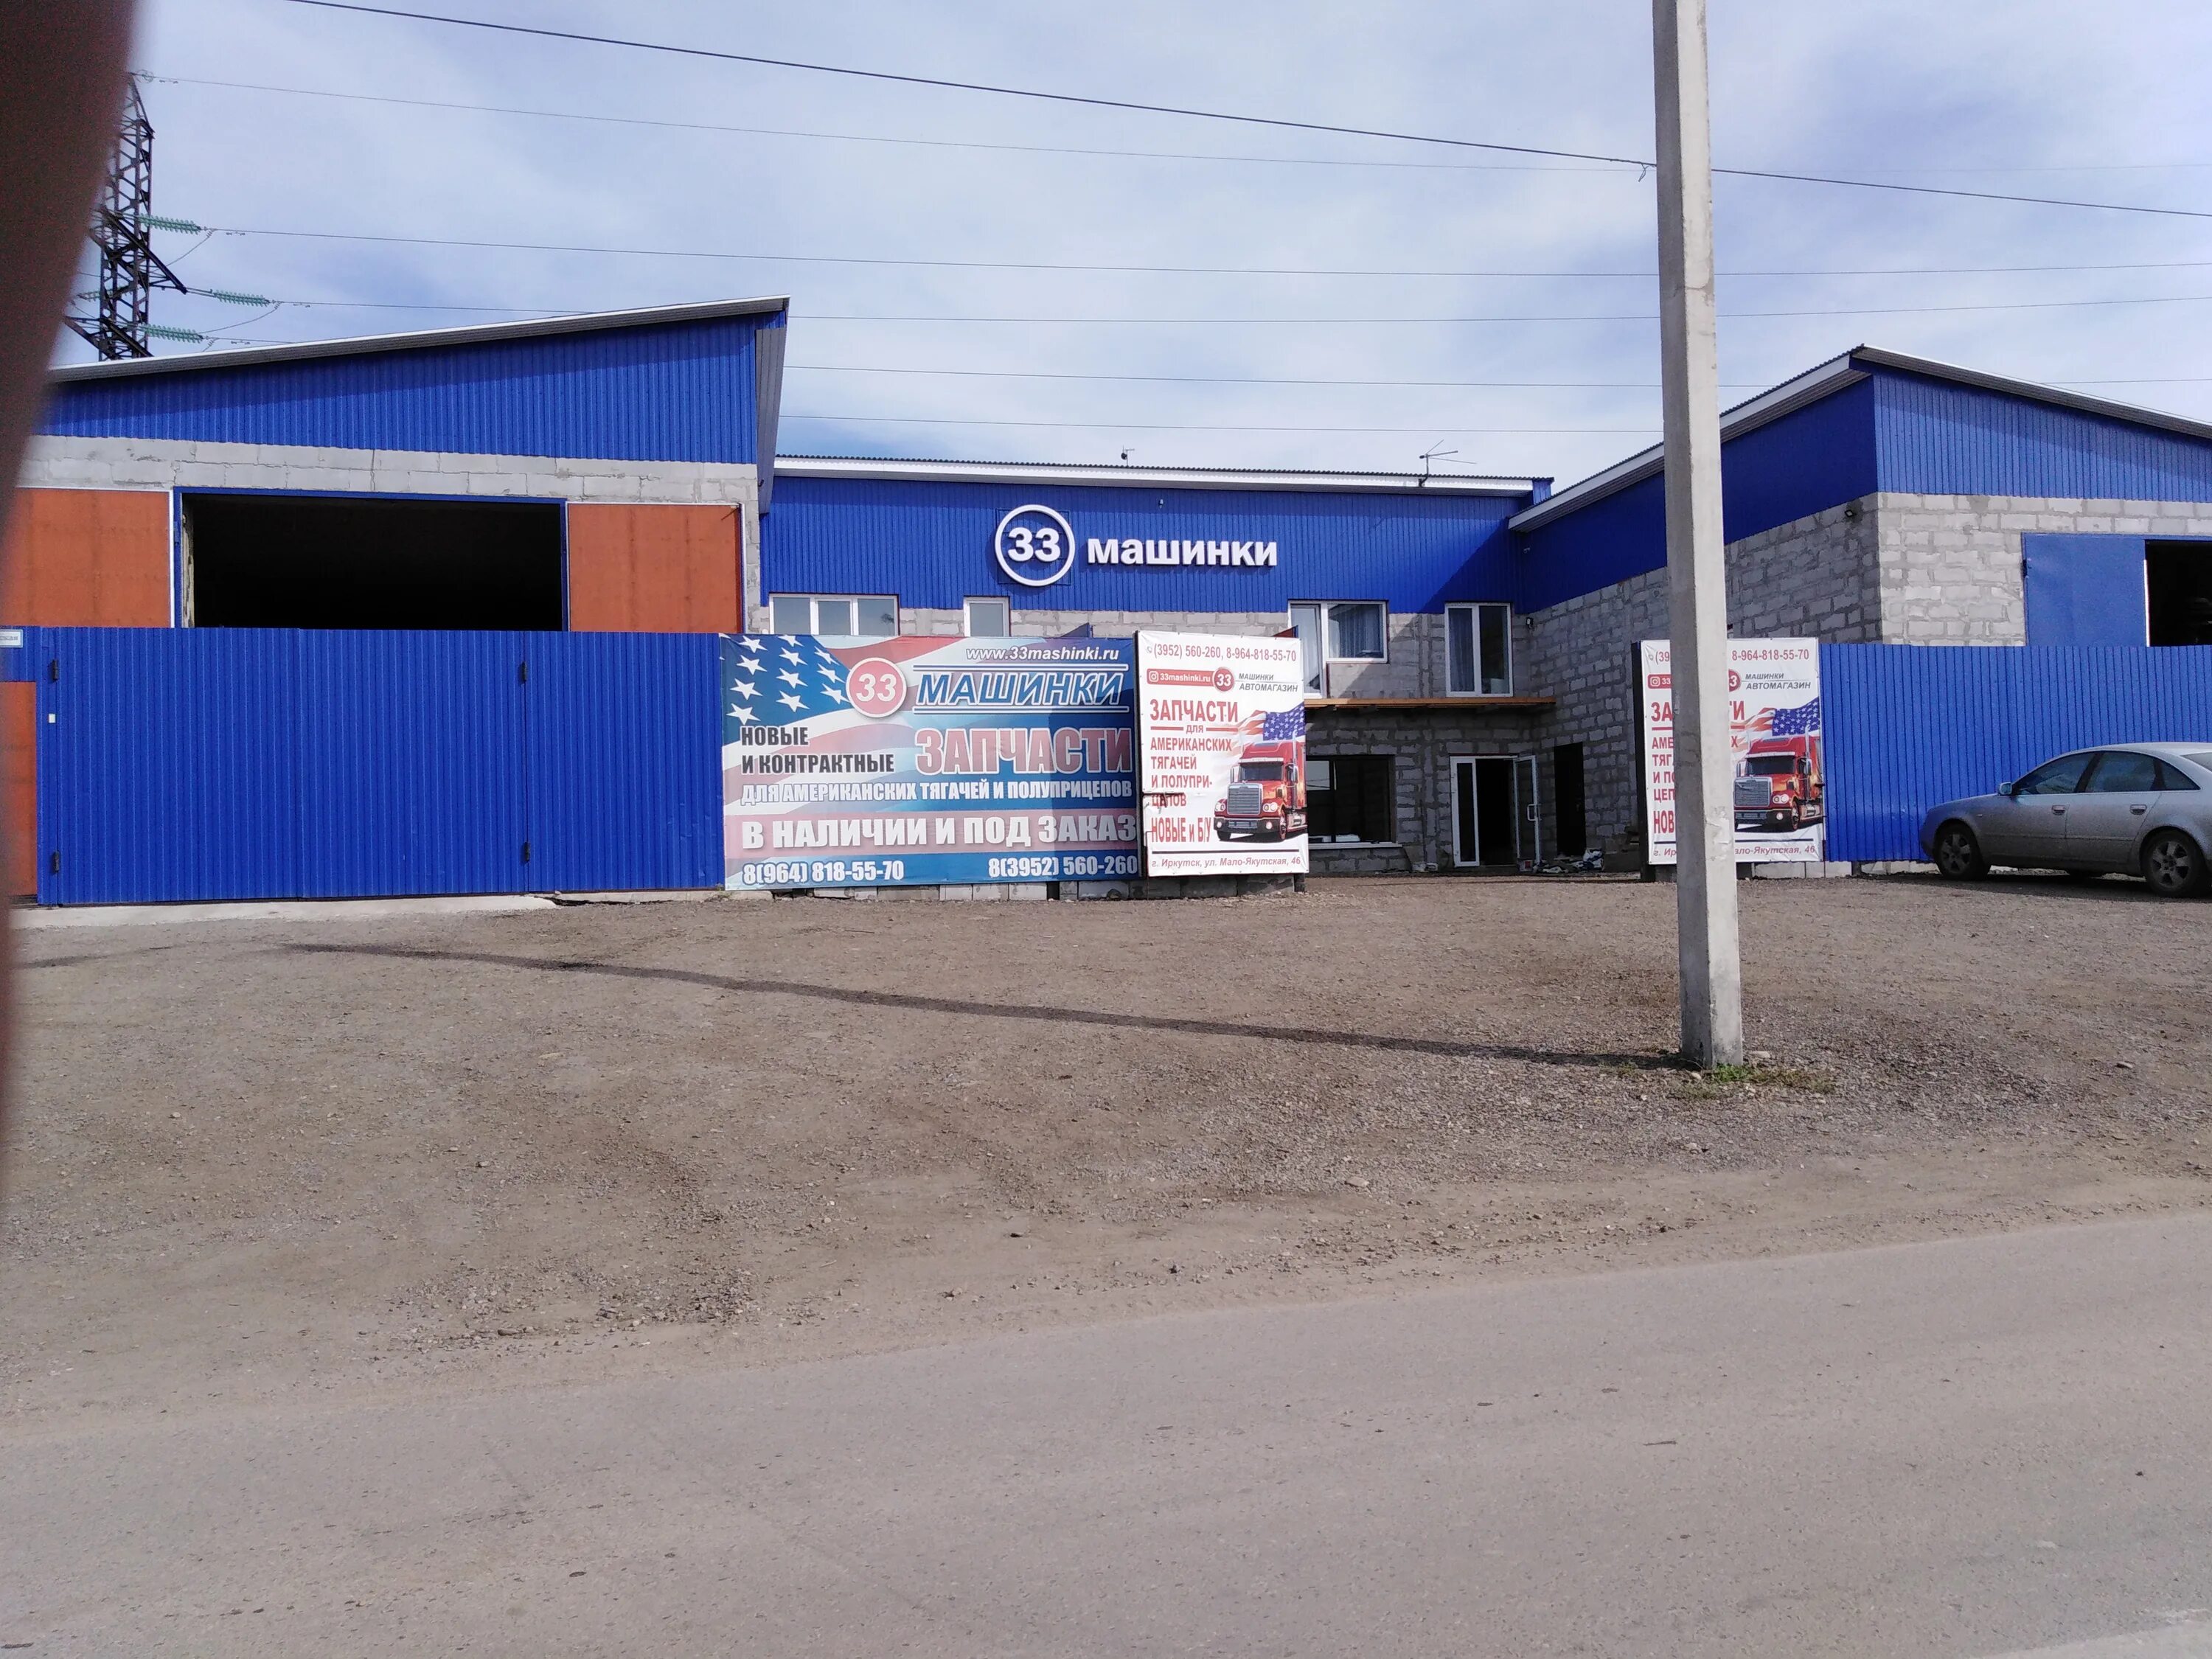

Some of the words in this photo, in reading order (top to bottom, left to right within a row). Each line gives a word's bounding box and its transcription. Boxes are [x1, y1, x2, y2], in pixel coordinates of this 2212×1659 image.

[1007, 526, 1061, 563] 33
[1088, 538, 1277, 566] машинки
[967, 647, 1119, 661] www.33mashinki.ru
[1154, 643, 1183, 659] (3952)
[1186, 645, 1224, 660] 560-260,
[1226, 647, 1296, 661] 8-964-818-55-70
[1732, 650, 1809, 661] 8-964-818-55-70
[1160, 673, 1211, 682] 33mashinki.ru
[1217, 675, 1231, 686] 33
[1239, 672, 1274, 681] МАШИНКИ
[856, 674, 897, 702] 33
[917, 672, 1124, 706] МАШИНКИ
[1239, 683, 1298, 692] АВТОМАГАЗИН
[1746, 682, 1811, 690] АВТОМАГАЗИН
[1150, 699, 1238, 722] ЗАПЧАСТИ
[741, 727, 809, 746] НОВЫЕ
[1150, 737, 1232, 751] АМЕРИКАНСКИХ
[915, 727, 1132, 775] ЗАПЧАСТИ
[742, 757, 754, 773] И
[759, 754, 894, 773] КОНТРАКТНЫЕ
[1151, 754, 1197, 769] ТЯГАЧЕЙ
[1152, 775, 1158, 787] И
[1161, 775, 1213, 788] ПОЛУПРИ-
[1653, 772, 1660, 783] И
[742, 785, 779, 805] ДЛЯ
[783, 783, 917, 801] АМЕРИКАНСКИХ
[919, 779, 990, 801] ТЯГАЧЕЙ
[993, 782, 1004, 799] И
[1007, 781, 1132, 800] ПОЛУПРИЦЕПОВ
[742, 822, 764, 849] В
[773, 818, 928, 848] НАЛИЧИИ
[936, 818, 956, 846] И
[964, 817, 1032, 847] ПОД
[1038, 815, 1136, 842] ЗАКАЗ
[1152, 817, 1186, 842] НОВЫЕ
[1197, 817, 1211, 842] Б/У
[988, 857, 1060, 877] 8(3952)
[1063, 855, 1137, 875] 560-260
[1161, 858, 1202, 869] Иркутск,
[1204, 860, 1217, 868] ул.
[1220, 858, 1289, 868] Мало-Якутская,
[1291, 857, 1301, 866] 46
[743, 862, 808, 885] 8(964)
[812, 860, 904, 881] 818-55-70
